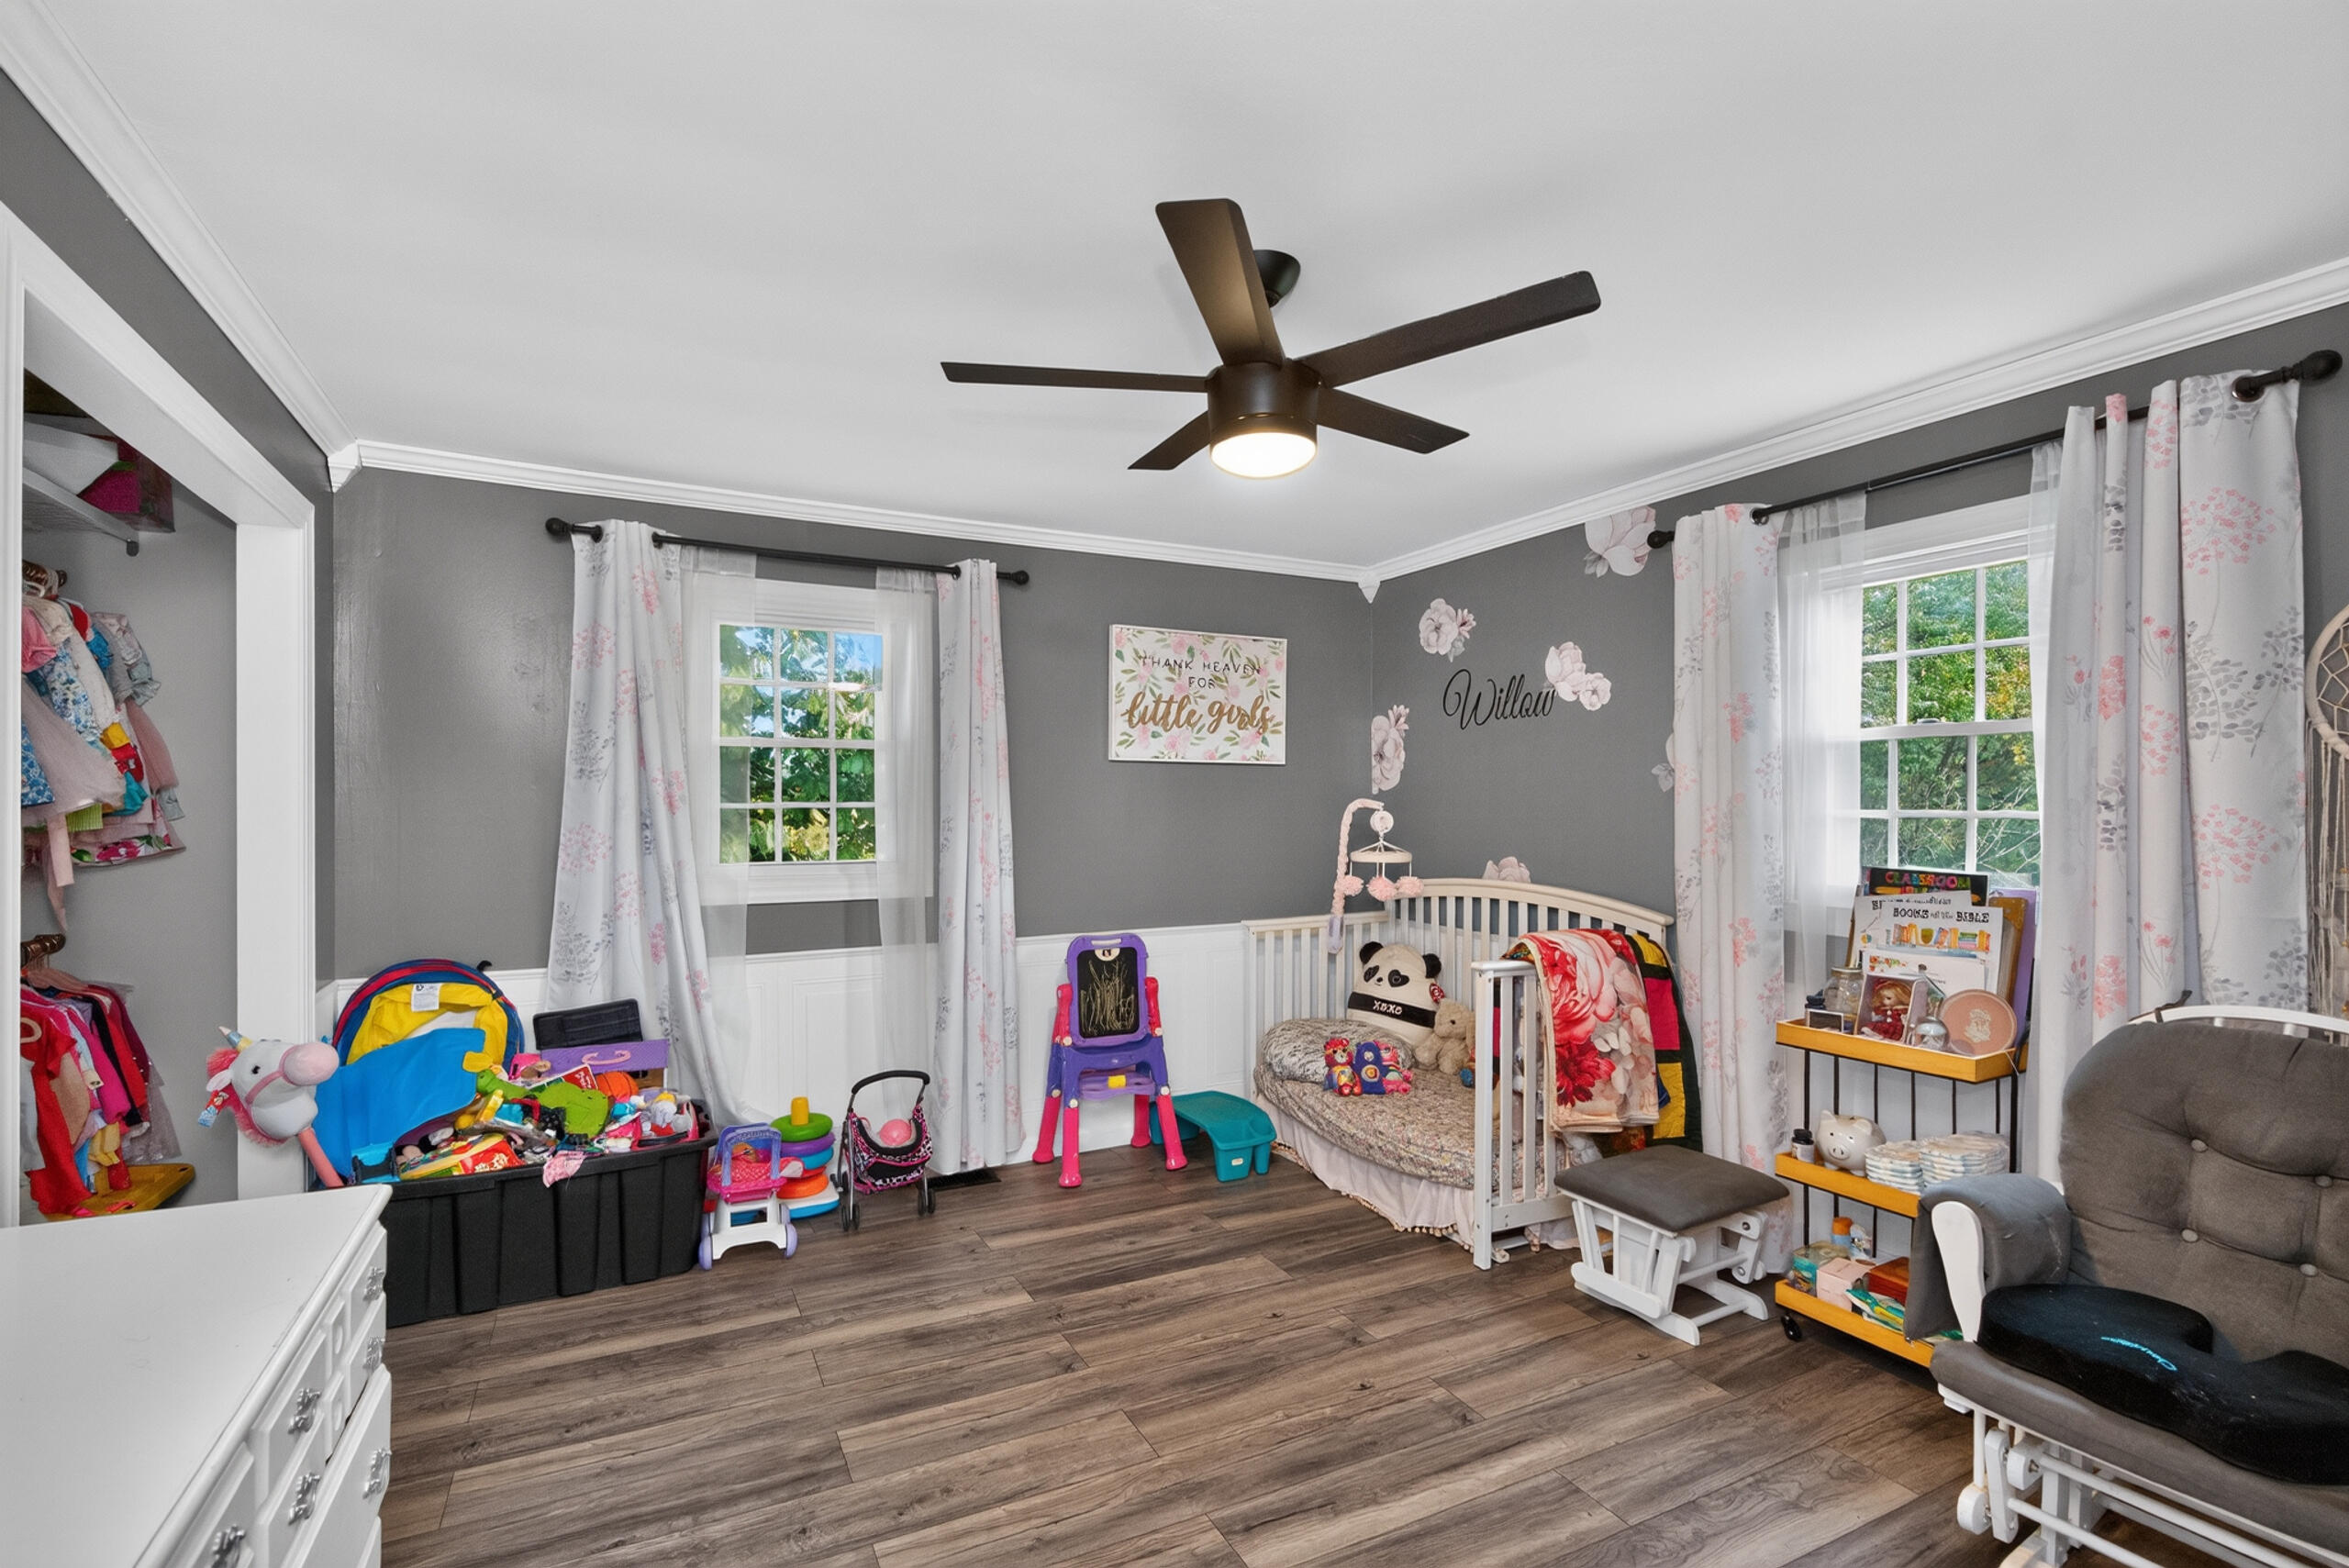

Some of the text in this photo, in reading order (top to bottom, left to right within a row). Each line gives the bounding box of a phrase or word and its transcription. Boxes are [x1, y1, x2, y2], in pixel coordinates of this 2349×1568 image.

[1141, 653, 1263, 675] THANK HEAVEN
[1188, 676, 1216, 689] FOR
[1442, 668, 1556, 730] Willow
[1120, 691, 1275, 734] little girls
[1893, 906, 1930, 918] BOOKS
[1955, 910, 1990, 923] BIBLE
[1373, 999, 1402, 1015] XOXO
